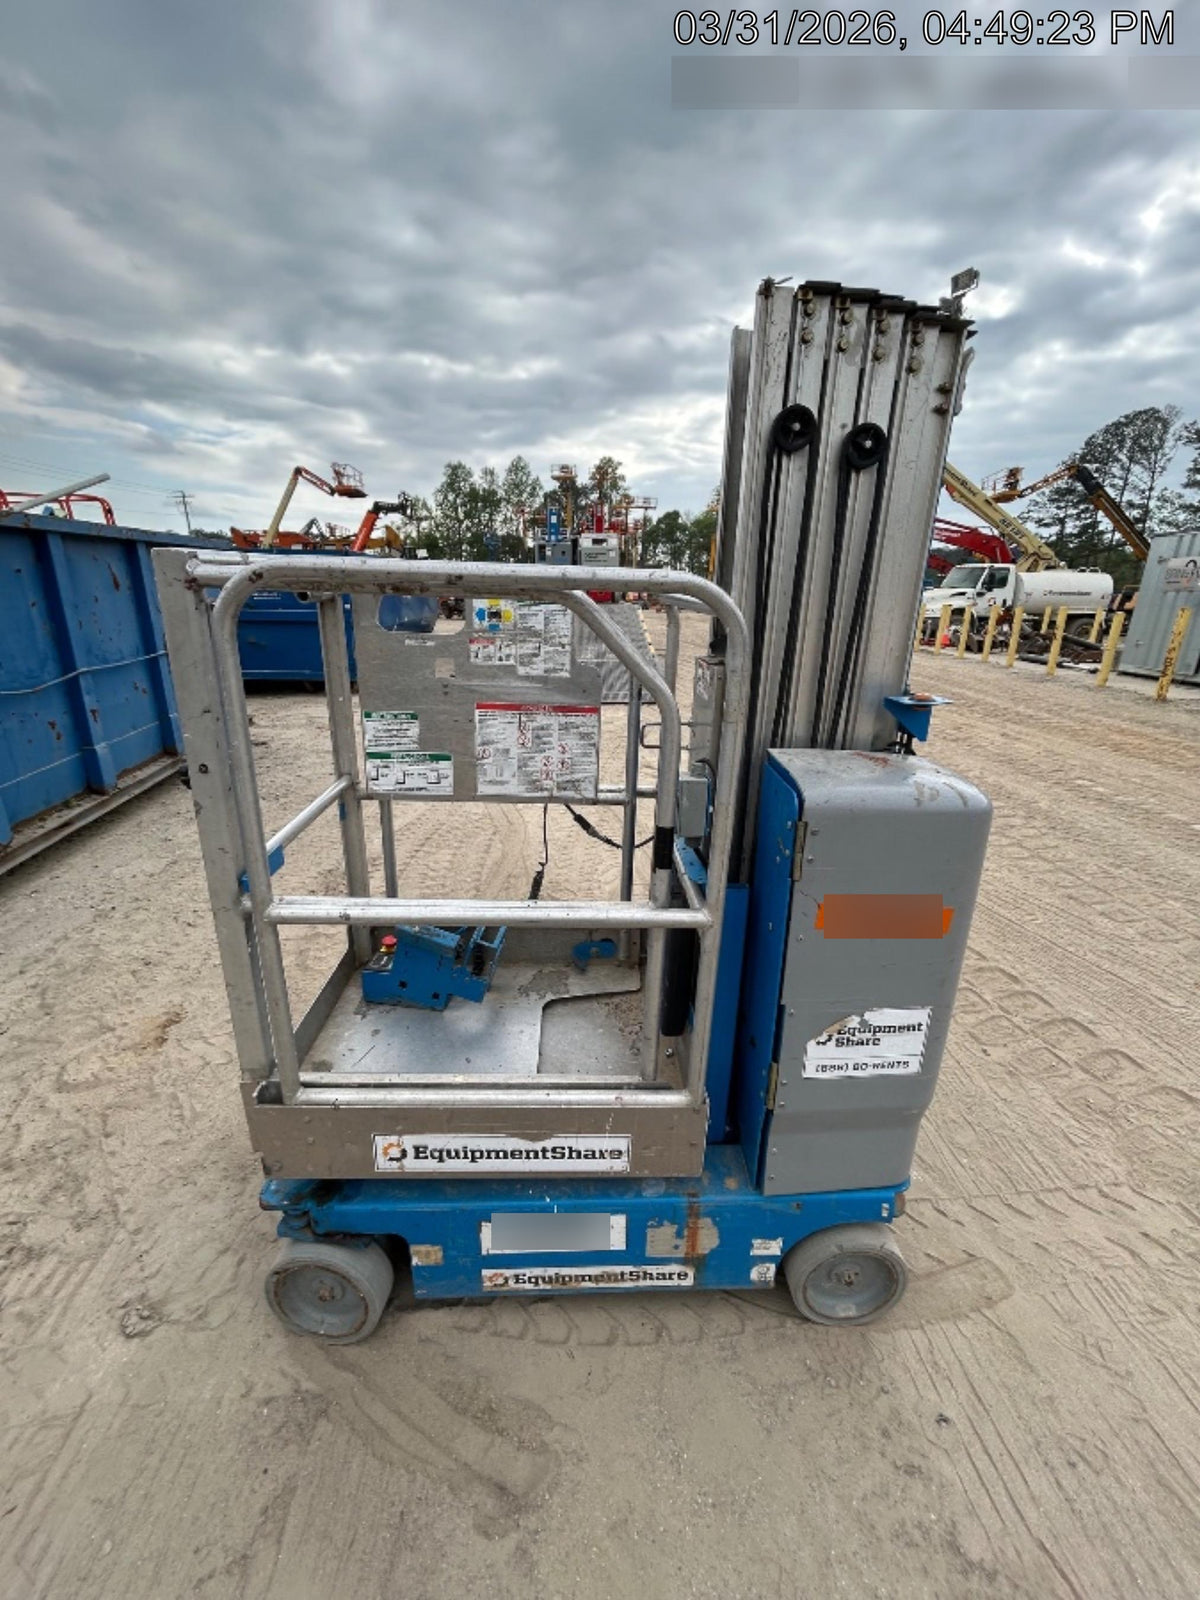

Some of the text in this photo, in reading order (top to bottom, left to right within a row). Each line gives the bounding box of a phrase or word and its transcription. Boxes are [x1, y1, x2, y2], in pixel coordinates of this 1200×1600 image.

[835, 1036, 881, 1048] Share
[412, 1145, 625, 1164] EquipmentShare
[513, 1268, 690, 1287] EquipmentShare
